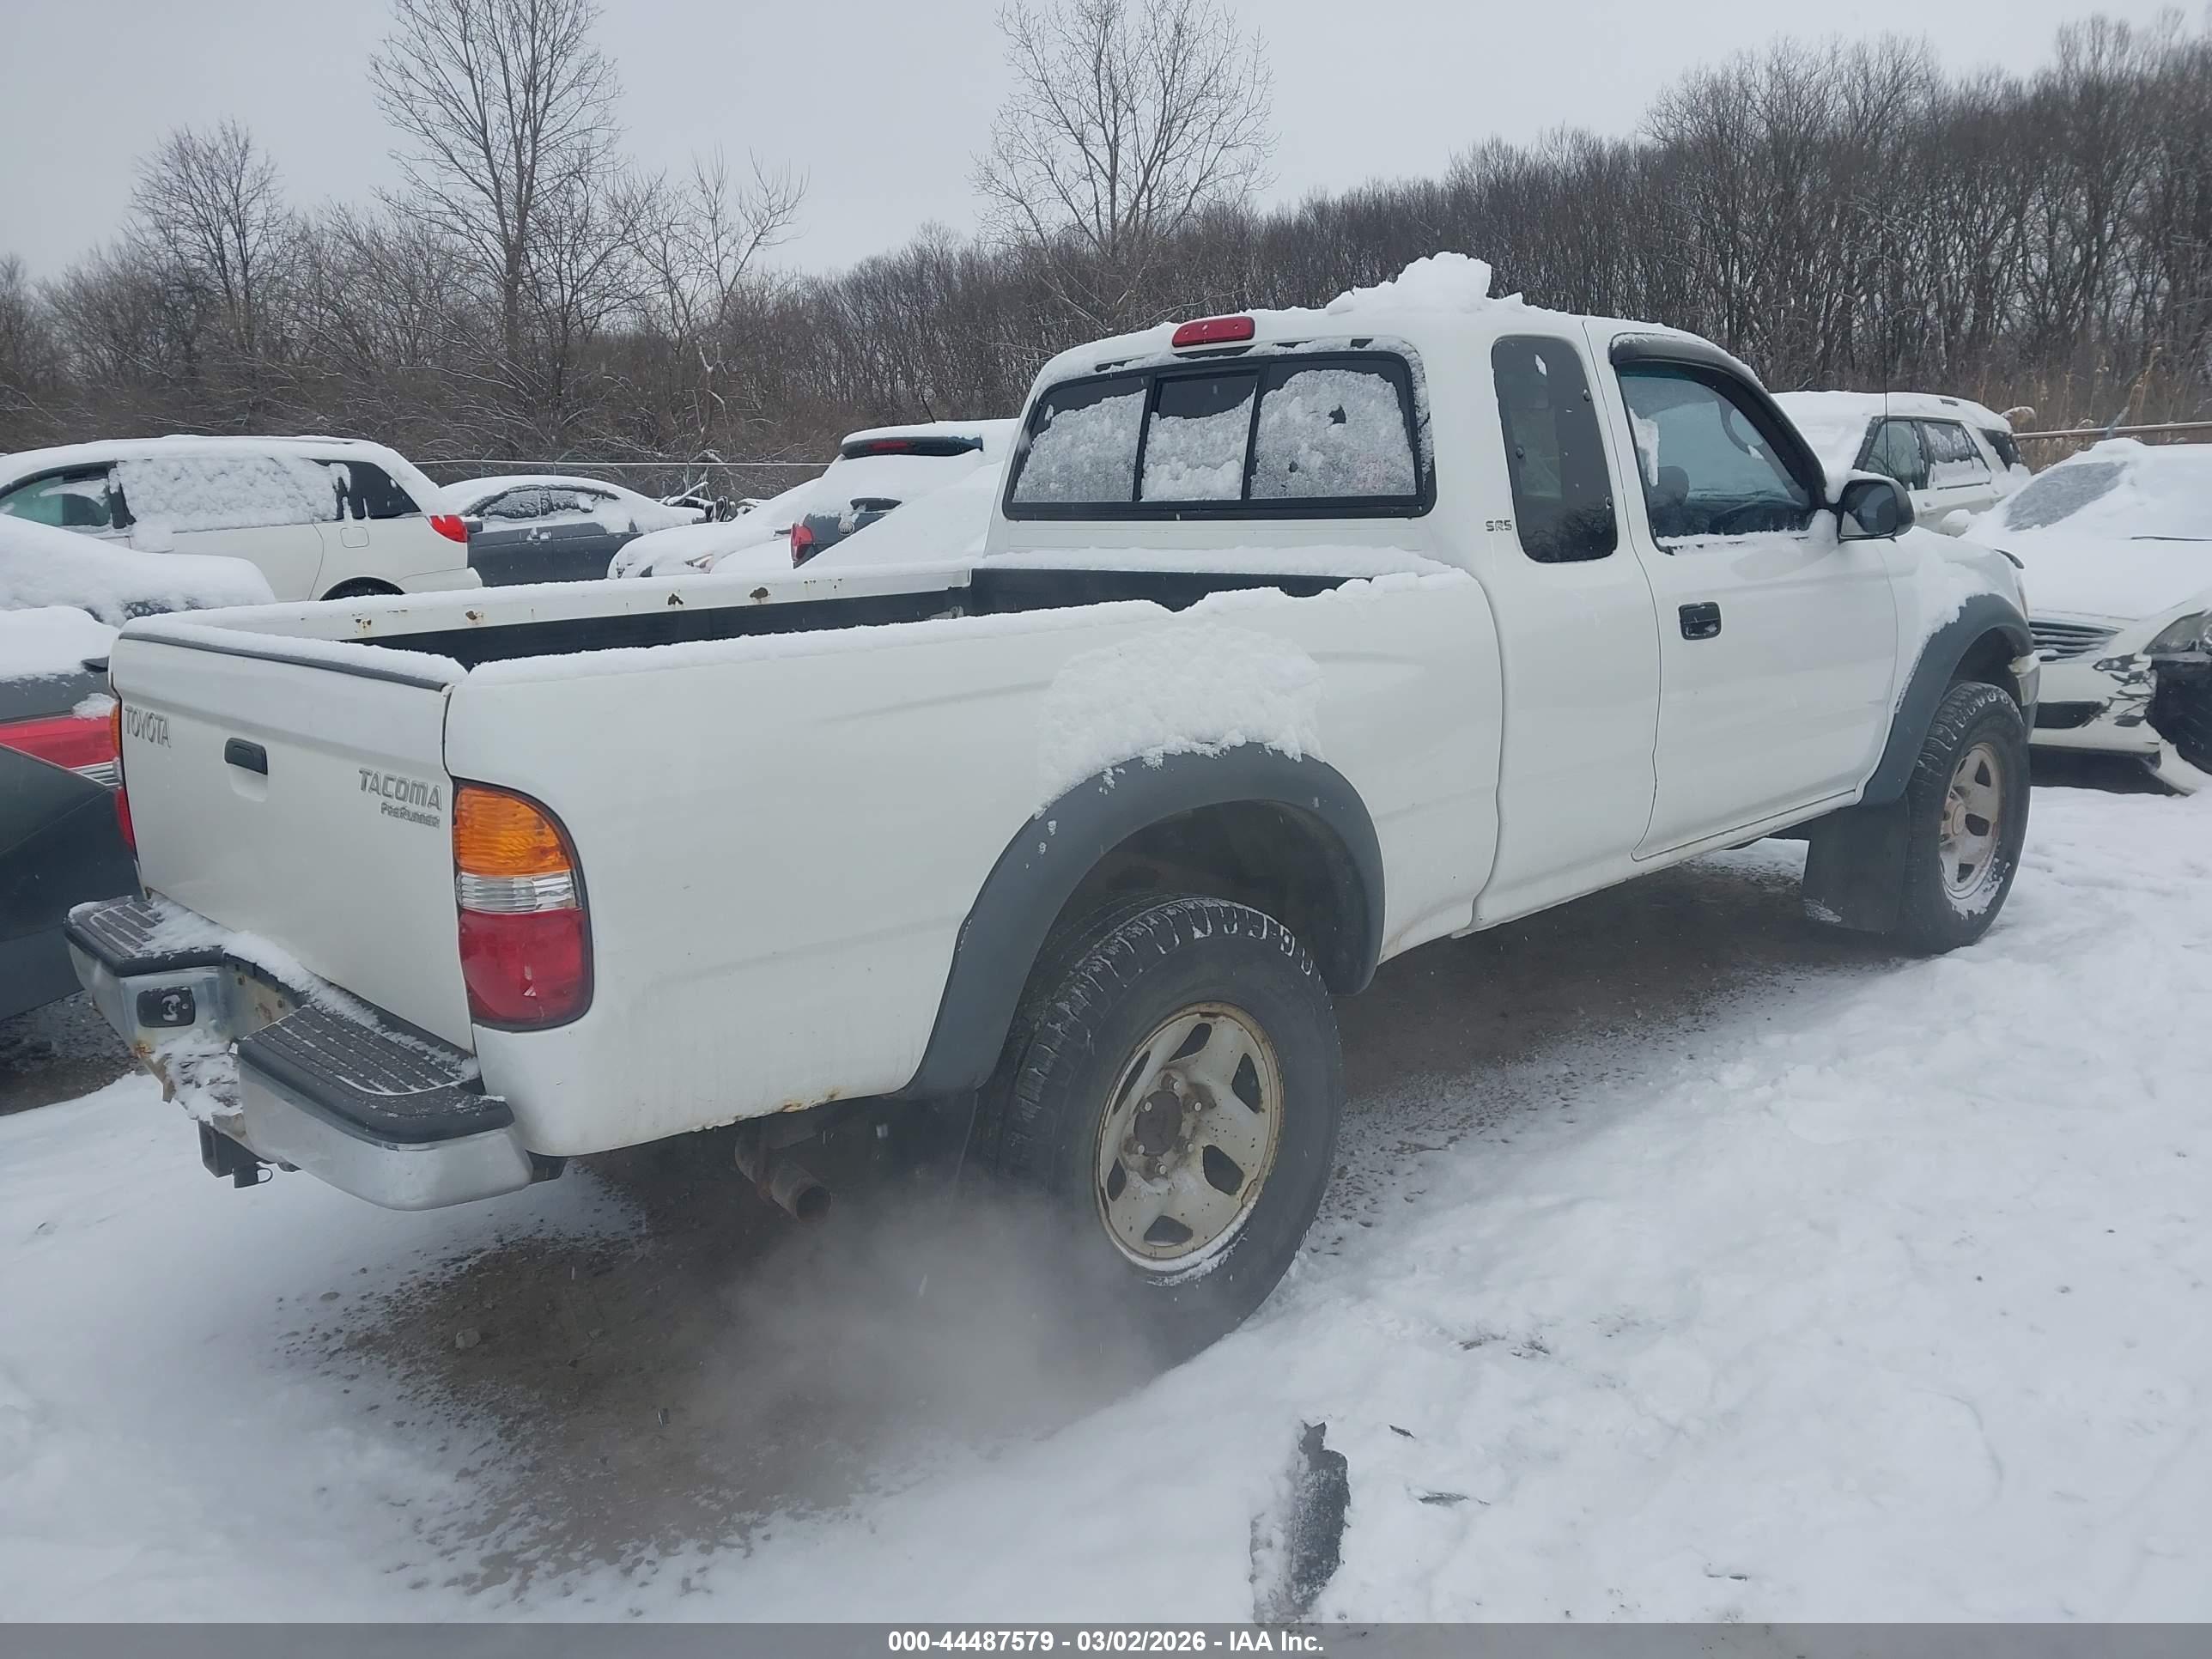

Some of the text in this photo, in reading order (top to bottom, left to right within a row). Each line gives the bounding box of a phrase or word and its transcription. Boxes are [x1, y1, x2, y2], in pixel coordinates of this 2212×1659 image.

[1485, 520, 1512, 532] SR5
[125, 705, 172, 749] TOYOTA
[359, 769, 442, 811] TACOMA
